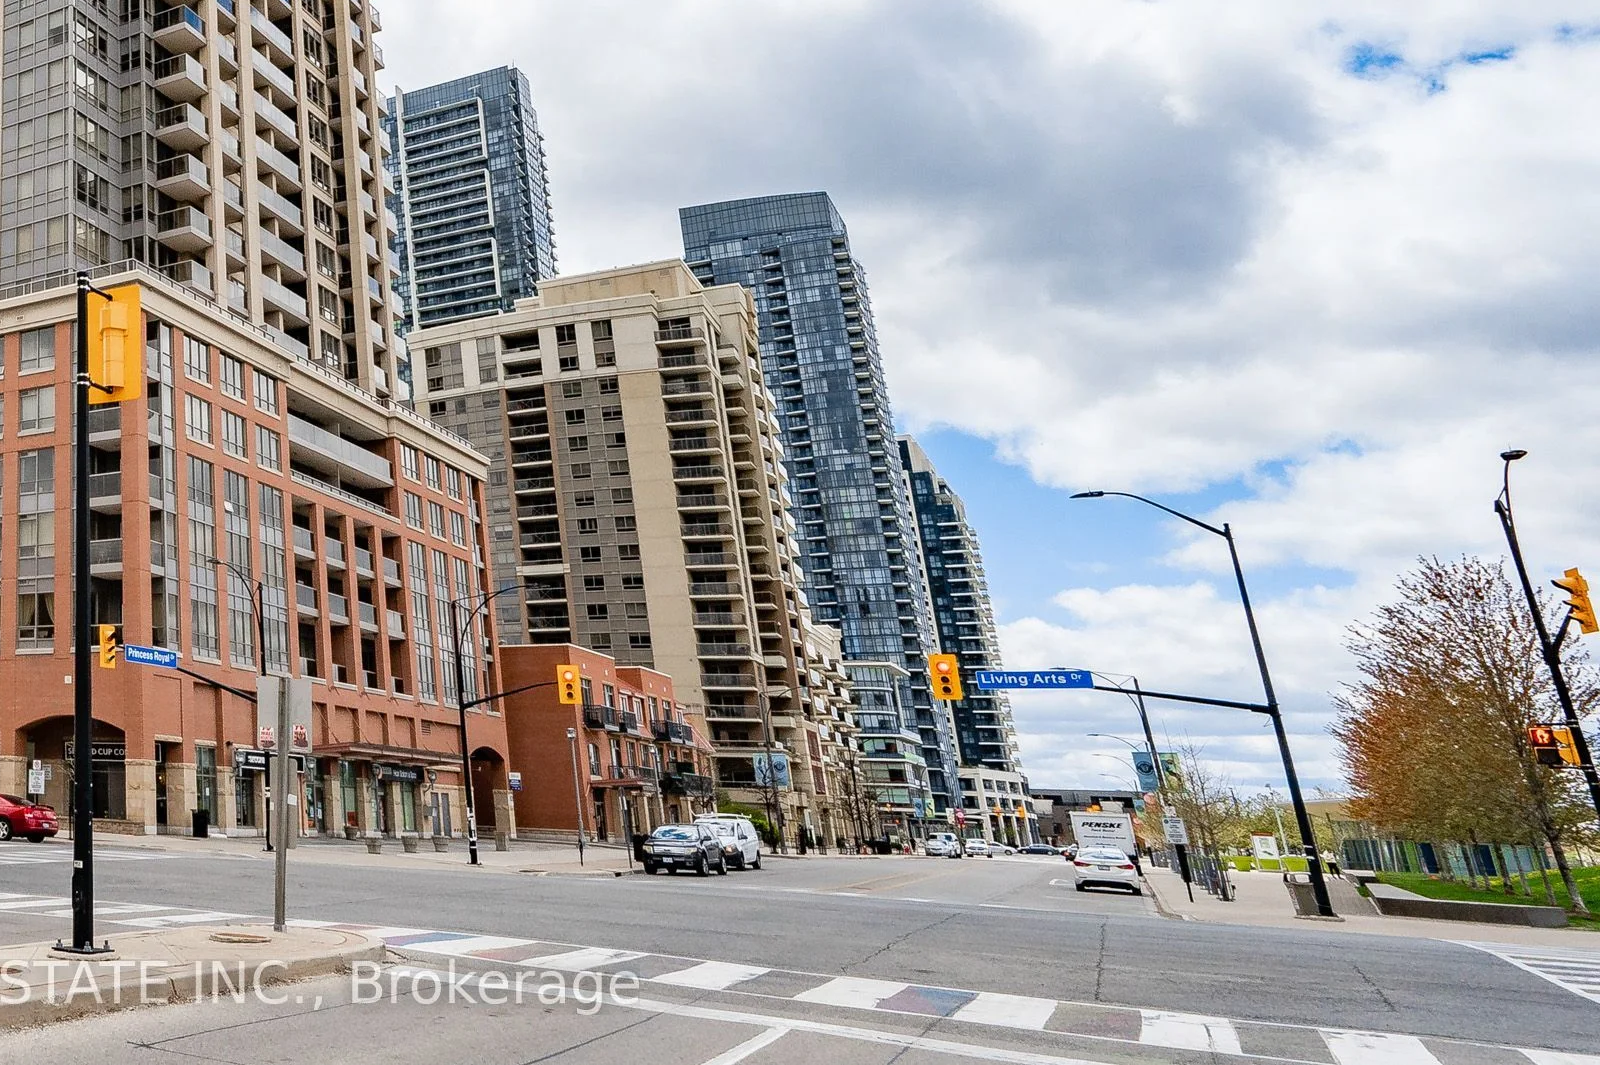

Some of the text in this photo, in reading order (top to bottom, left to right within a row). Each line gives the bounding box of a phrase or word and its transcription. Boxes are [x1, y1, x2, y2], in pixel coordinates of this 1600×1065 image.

[128, 647, 153, 660] Princess
[154, 651, 170, 664] Royal
[980, 673, 1029, 686] Living
[1033, 673, 1067, 684] Arts
[97, 747, 113, 756] CUP
[1081, 821, 1123, 829] PENSKE
